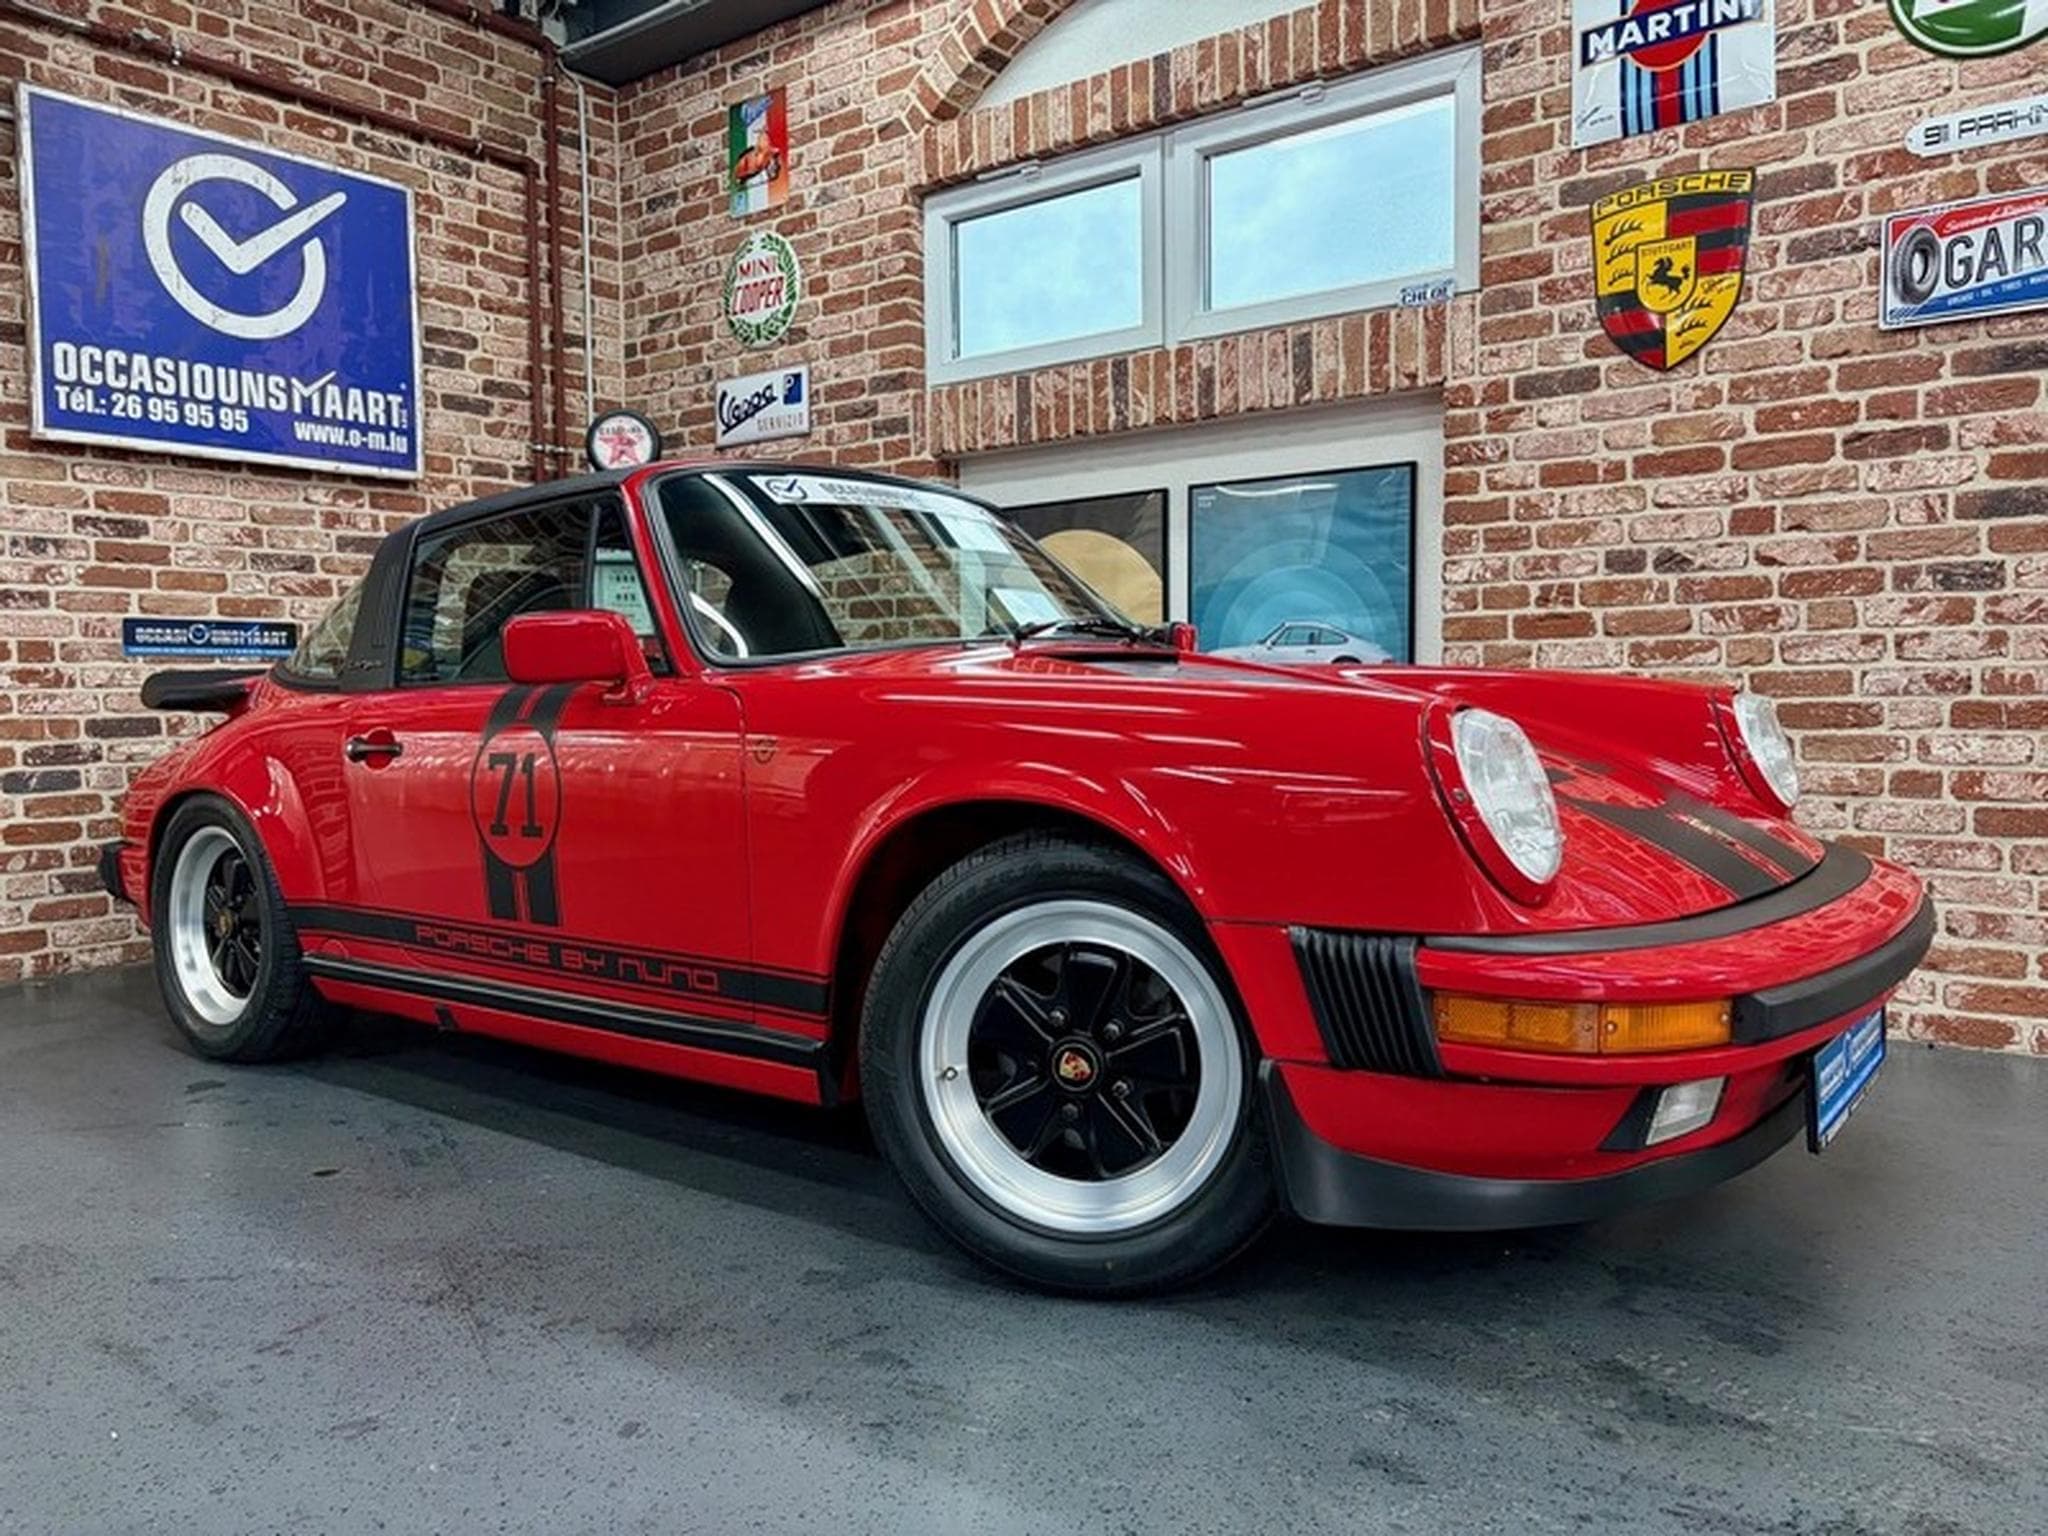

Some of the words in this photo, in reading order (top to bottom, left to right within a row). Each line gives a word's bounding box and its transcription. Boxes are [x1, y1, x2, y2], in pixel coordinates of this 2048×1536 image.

[1597, 173, 1748, 215] PORSCHE
[737, 255, 777, 278] MINI
[732, 276, 784, 315] COOPER
[53, 341, 403, 429] OCCASIOUNSMAART
[110, 391, 143, 419] 26
[147, 398, 180, 424] 95
[183, 402, 216, 429] 95
[218, 406, 249, 432] 95
[293, 420, 408, 454] www.o-m.lu
[488, 752, 543, 837] 71
[415, 924, 551, 964] PORSCHE
[560, 950, 606, 973] BY
